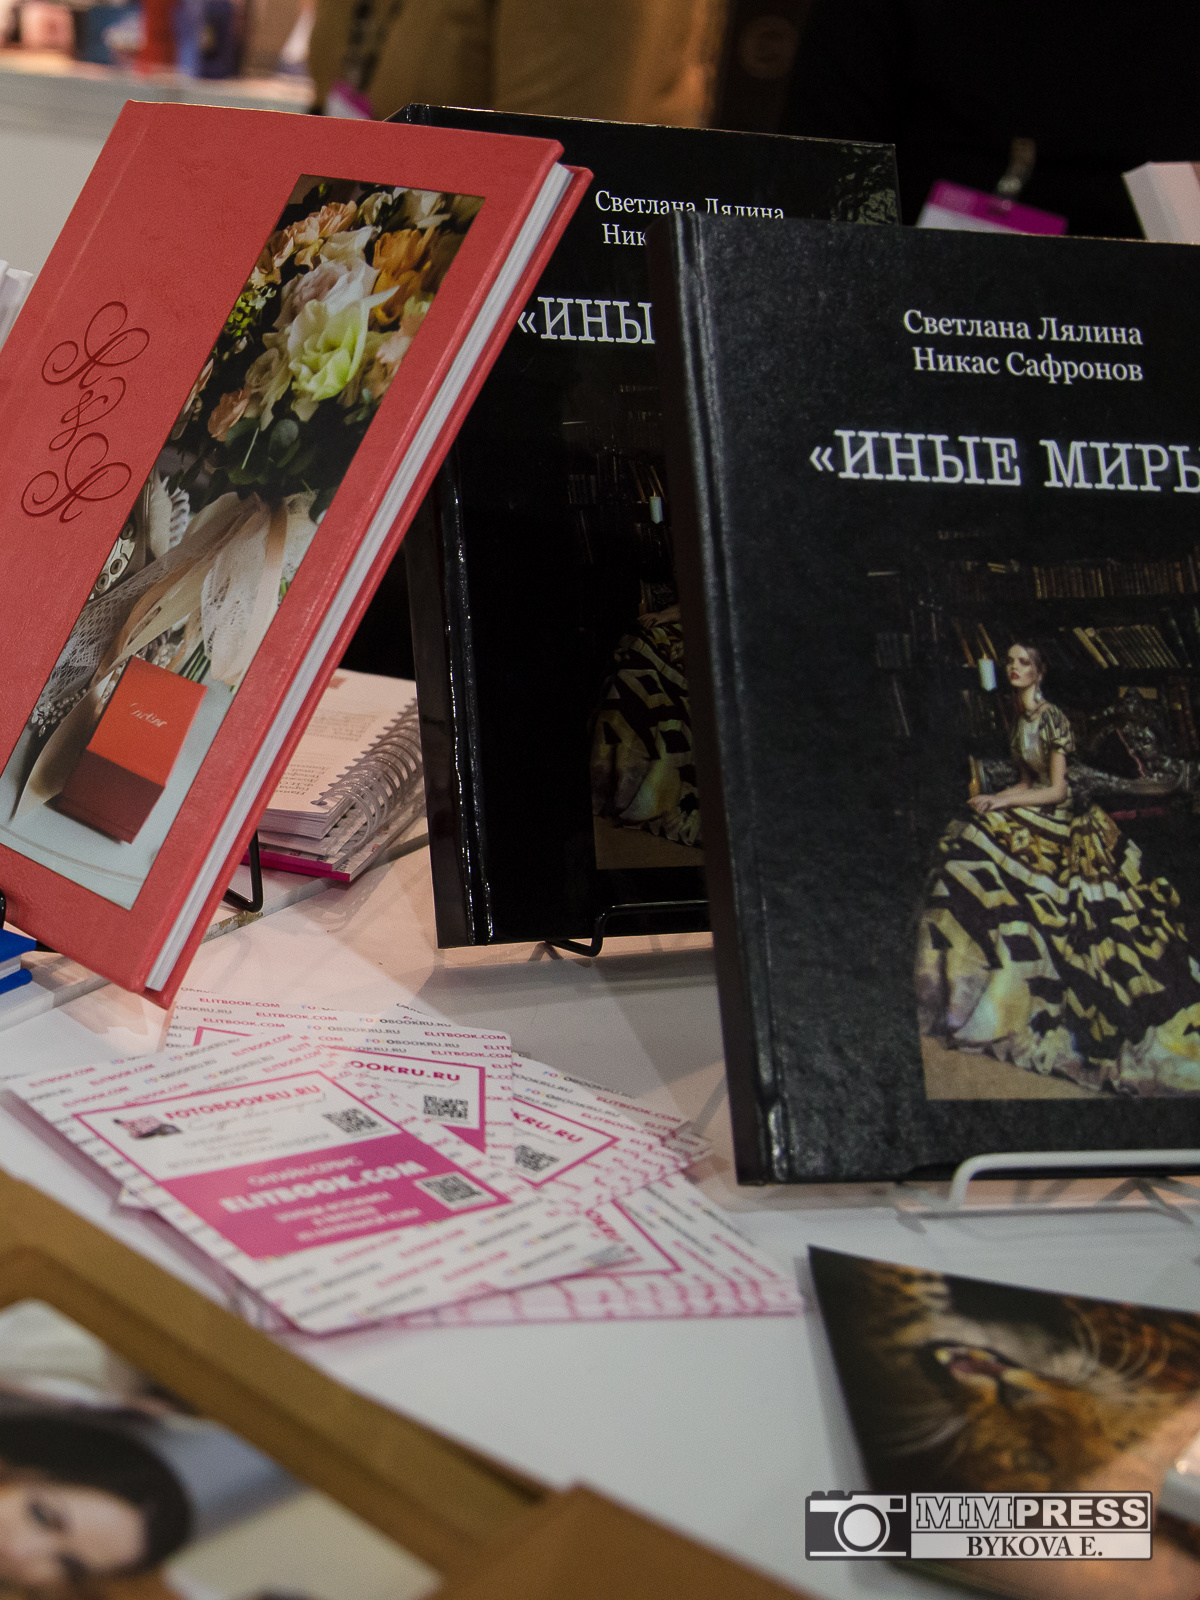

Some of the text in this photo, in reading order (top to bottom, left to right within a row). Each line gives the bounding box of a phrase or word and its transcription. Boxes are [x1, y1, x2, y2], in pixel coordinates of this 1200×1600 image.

[595, 190, 696, 215] Светлана
[602, 223, 647, 246] Ник
[517, 296, 656, 345] «ИНЫ
[903, 309, 1144, 345] Светлана Лялина
[912, 346, 1144, 385] Никас Сафронов
[809, 429, 1021, 486] «ИНЫЕ
[350, 1060, 461, 1082] OOKRU.RU
